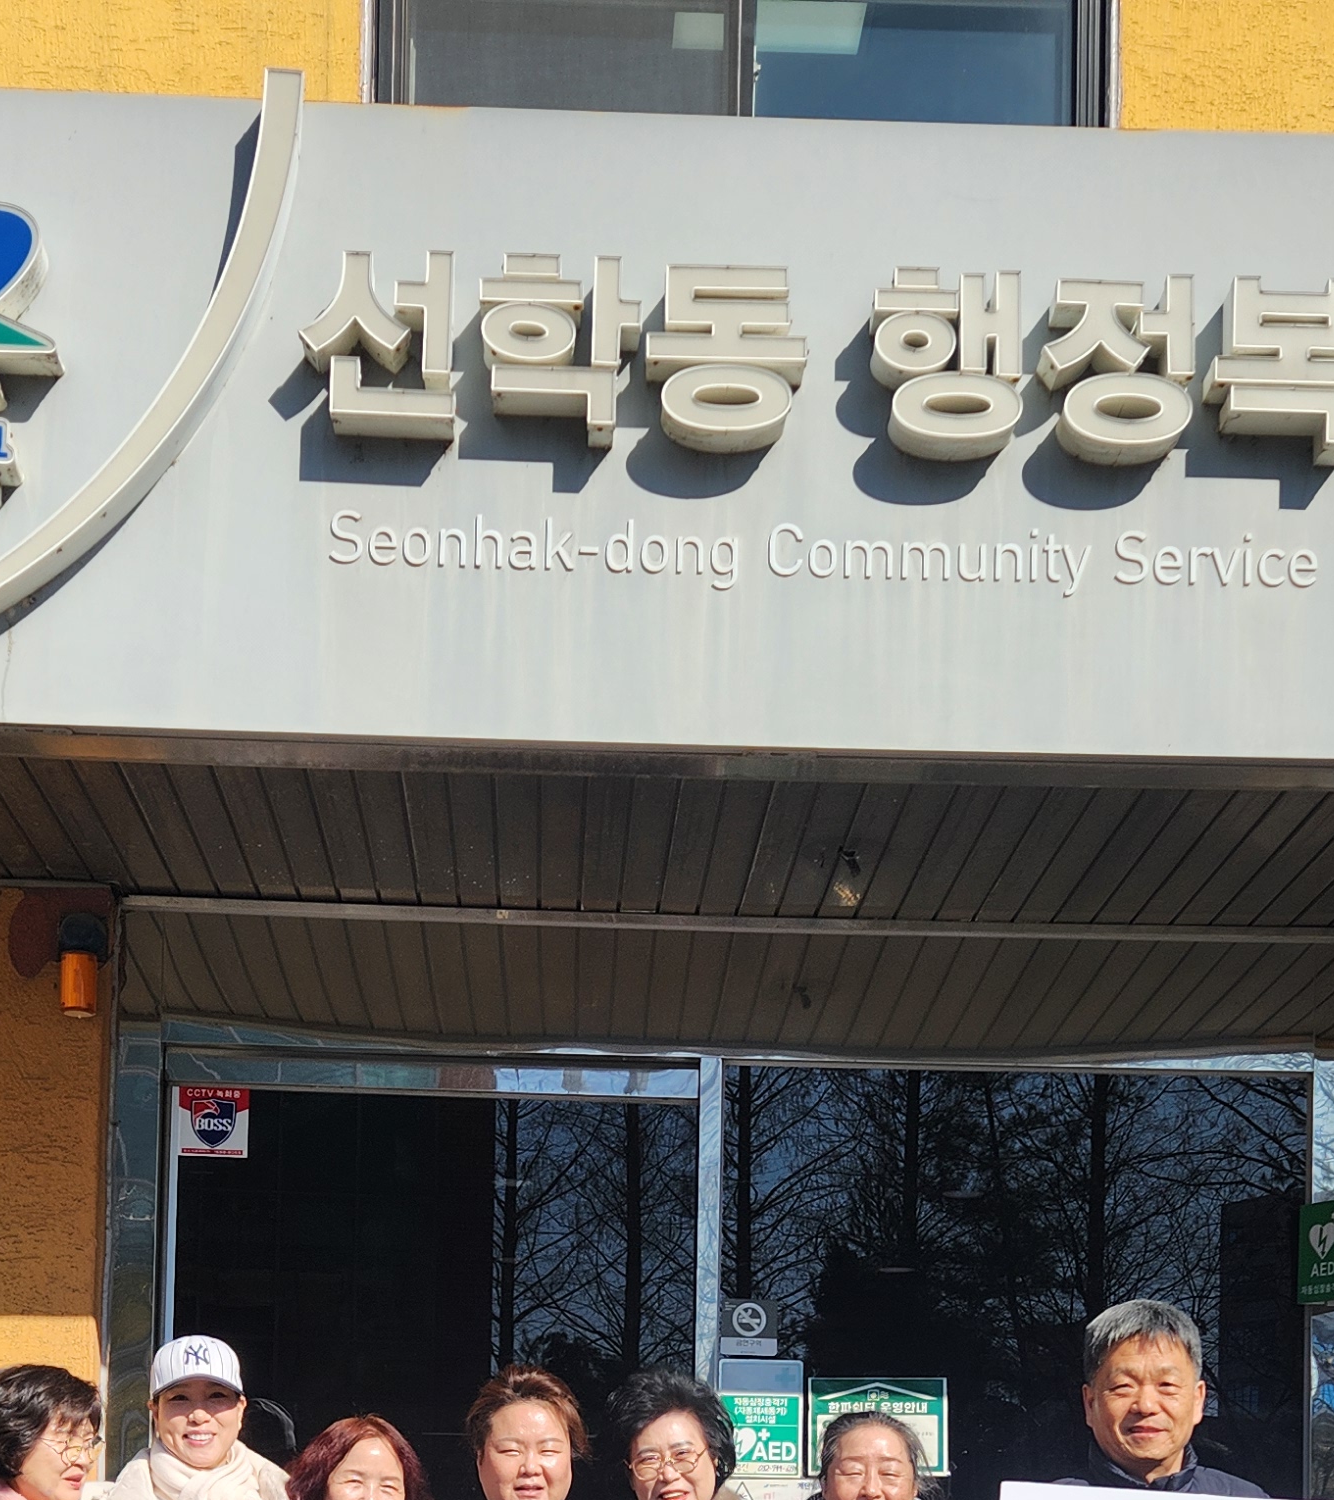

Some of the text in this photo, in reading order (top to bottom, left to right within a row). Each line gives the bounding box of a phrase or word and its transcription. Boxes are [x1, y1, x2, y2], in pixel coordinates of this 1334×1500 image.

[297, 250, 808, 455] 선학동
[329, 510, 738, 590] Seonhak-dong
[766, 521, 1091, 597] Community
[1114, 531, 1318, 589] Service
[187, 1088, 214, 1097] CCTV
[195, 1117, 232, 1131] BOSS
[880, 1402, 928, 1413] 운영안내
[752, 1442, 797, 1461] AED
